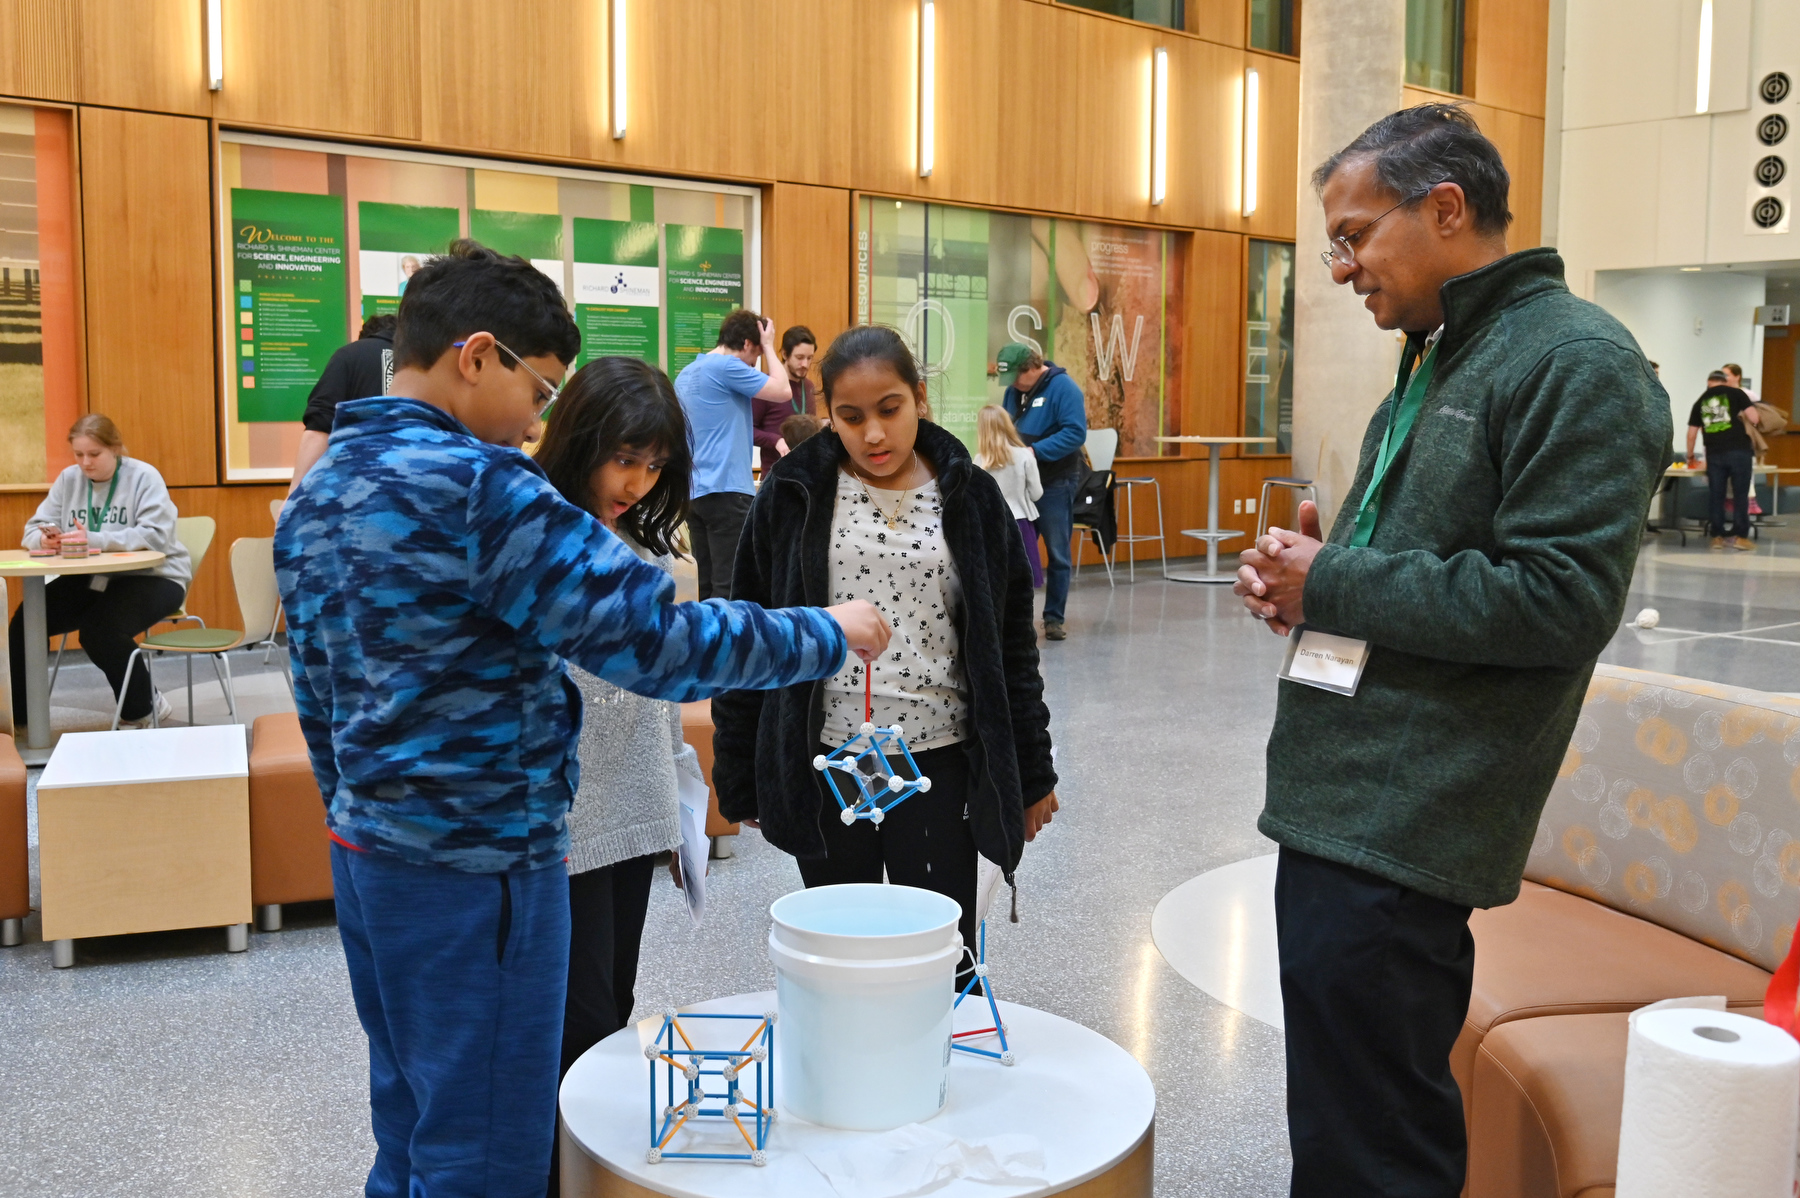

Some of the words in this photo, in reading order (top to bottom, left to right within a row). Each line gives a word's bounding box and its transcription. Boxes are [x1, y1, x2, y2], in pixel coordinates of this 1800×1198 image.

[306, 235, 317, 243] TO
[319, 236, 335, 244] THE
[237, 243, 269, 251] RICHARD
[278, 245, 313, 254] SHINEMAN
[314, 247, 341, 255] CENTER
[1091, 241, 1129, 255] progress
[237, 252, 253, 260] FOR
[253, 252, 289, 262] SCIENCE,
[289, 254, 341, 264] ENGINEERING
[257, 262, 274, 270] AND
[275, 263, 322, 272] INNOVATION
[858, 231, 868, 326] RESOURCES
[1300, 648, 1324, 660] Darren
[1324, 653, 1354, 665] Narayan
